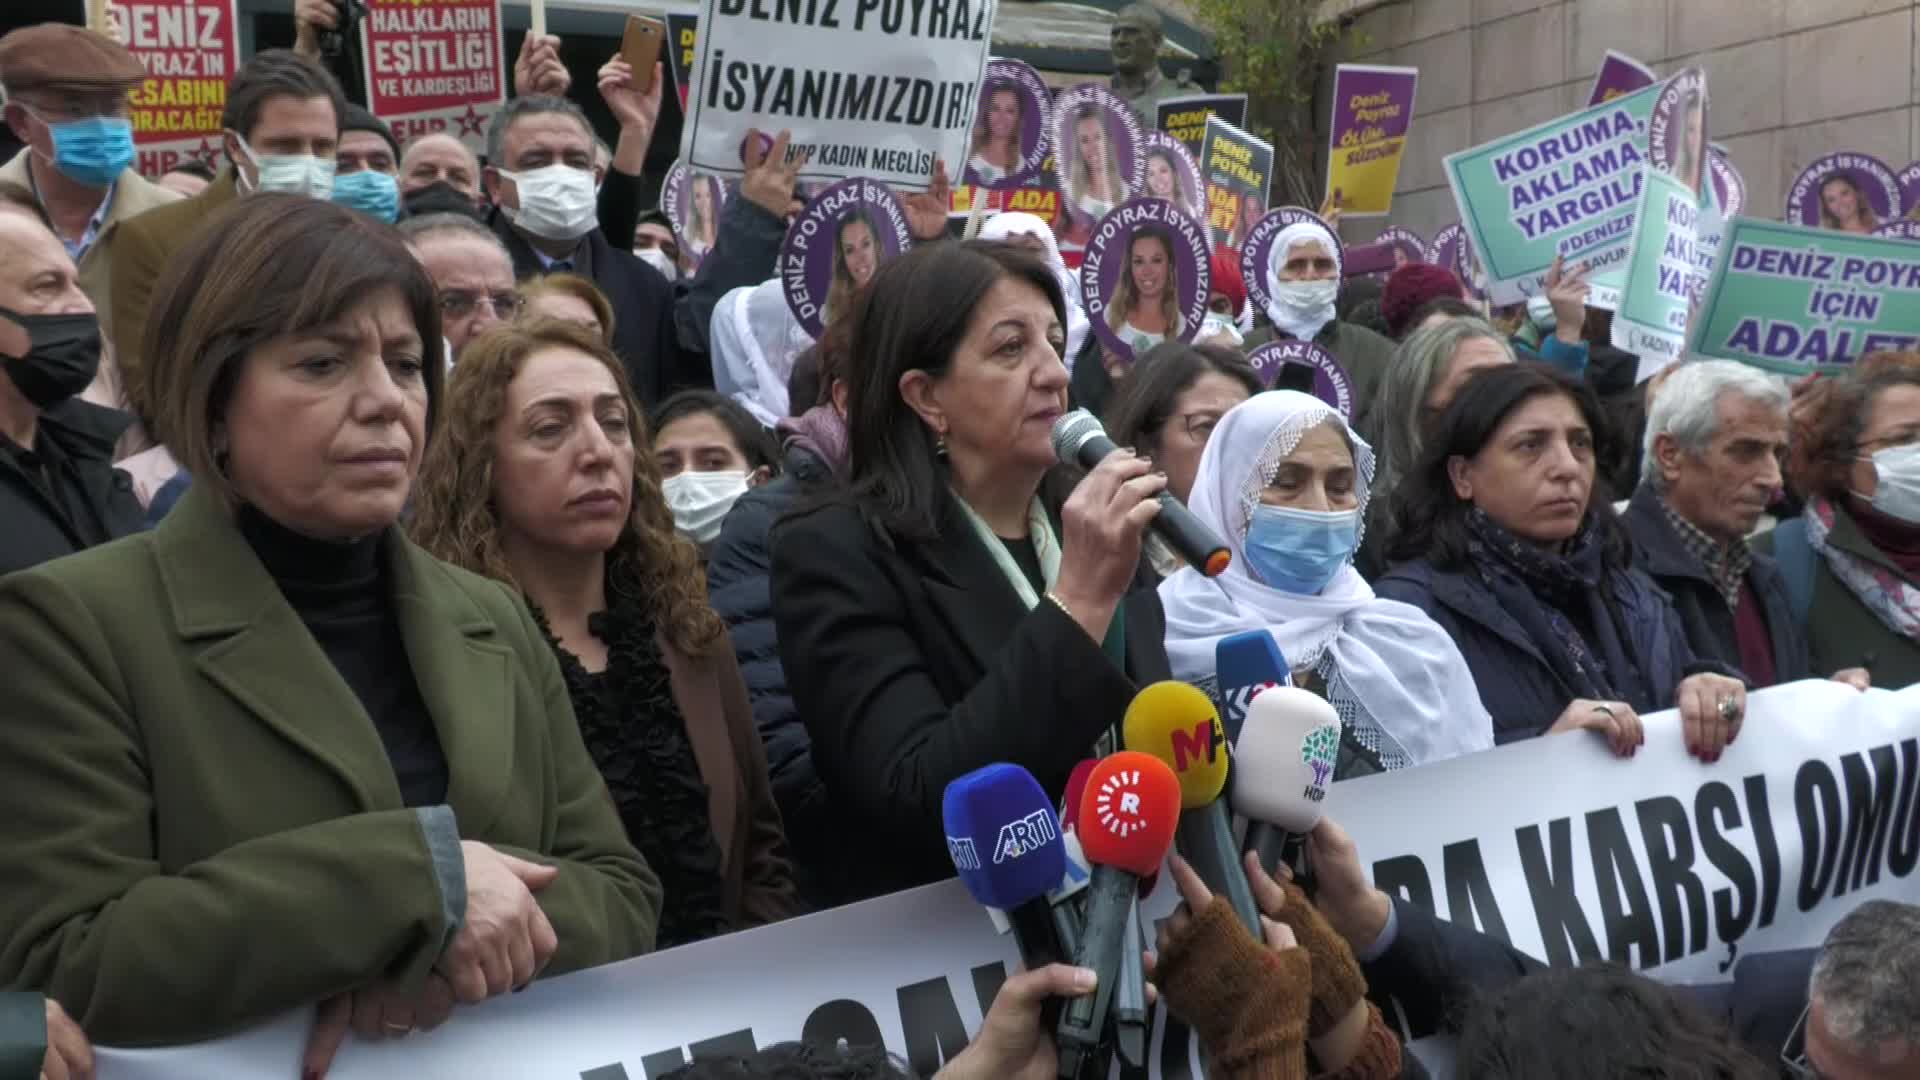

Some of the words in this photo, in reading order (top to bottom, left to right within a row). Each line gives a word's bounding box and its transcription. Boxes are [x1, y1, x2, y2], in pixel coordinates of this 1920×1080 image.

[371, 8, 491, 32] HALKLARIN
[373, 33, 494, 76] EŞİTLİĞİ
[128, 79, 225, 106] ESABINI
[378, 79, 399, 97] VE
[403, 71, 496, 97] KARDEŞLİĞİ
[706, 48, 977, 129] İSYANIMIZDIR!
[139, 150, 178, 176] HP
[818, 144, 868, 169] KADIN
[1494, 110, 1645, 182] KORUMA,
[793, 184, 860, 250] POYRAZ
[1009, 190, 1056, 210] ADA
[1243, 215, 1281, 267] POYRAZ
[1085, 251, 1103, 315] DENİZ
[1094, 203, 1160, 250] POYRAZ
[1163, 203, 1209, 330] İSYANIMIZDIR!
[1732, 246, 1836, 280] DENİZ
[785, 254, 818, 320] DENİZ
[1809, 284, 1879, 322] İÇİN
[1251, 344, 1303, 370] OYRAZ
[1120, 791, 1140, 816] R
[992, 807, 1056, 864] ARTI
[1514, 774, 1782, 975] KARŞI
[1794, 737, 1920, 913] OMU
